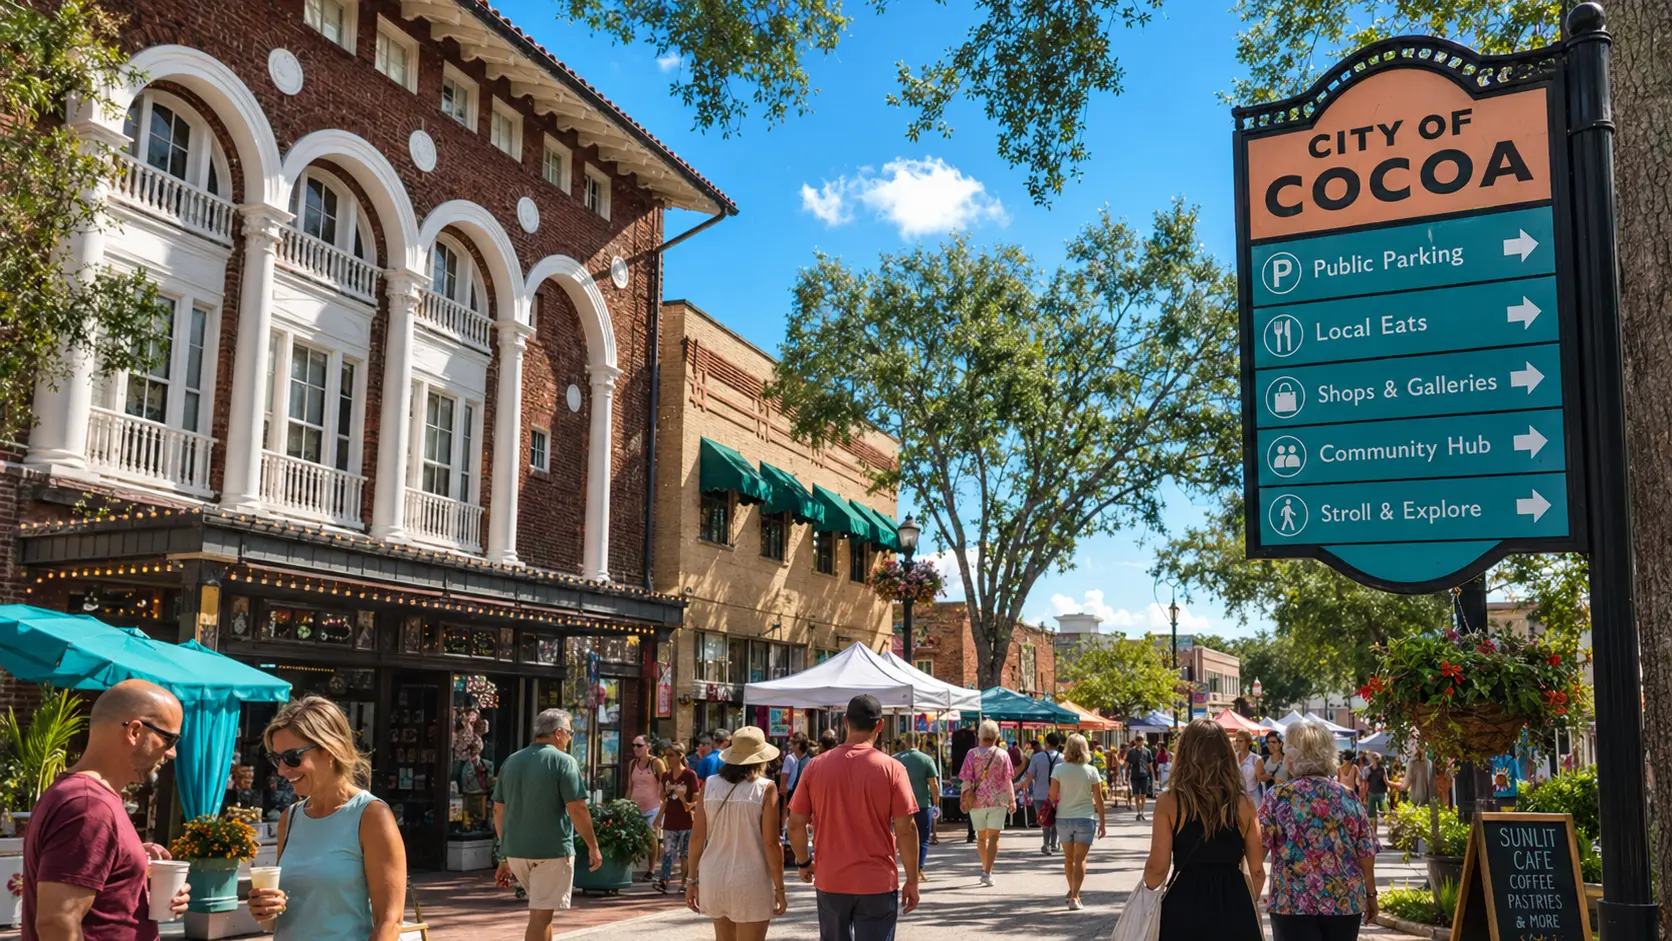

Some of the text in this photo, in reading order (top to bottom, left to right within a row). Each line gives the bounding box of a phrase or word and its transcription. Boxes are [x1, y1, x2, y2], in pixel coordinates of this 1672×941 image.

[1308, 108, 1473, 159] CITY OF
[1265, 140, 1534, 218] COCOA
[1273, 259, 1293, 288] P
[1314, 246, 1464, 279] Public Parking
[1316, 315, 1428, 341] Local Eats
[1318, 373, 1498, 406] Shops & Galleries
[1319, 434, 1491, 463] Community Hub
[1321, 499, 1482, 524] Stroll & Explore
[1500, 827, 1556, 848] SUNLIT
[1513, 850, 1554, 870] CAFE
[1509, 874, 1556, 890] COFFEE
[1507, 893, 1563, 910] PASTRIES
[1516, 914, 1560, 929] & MORE
